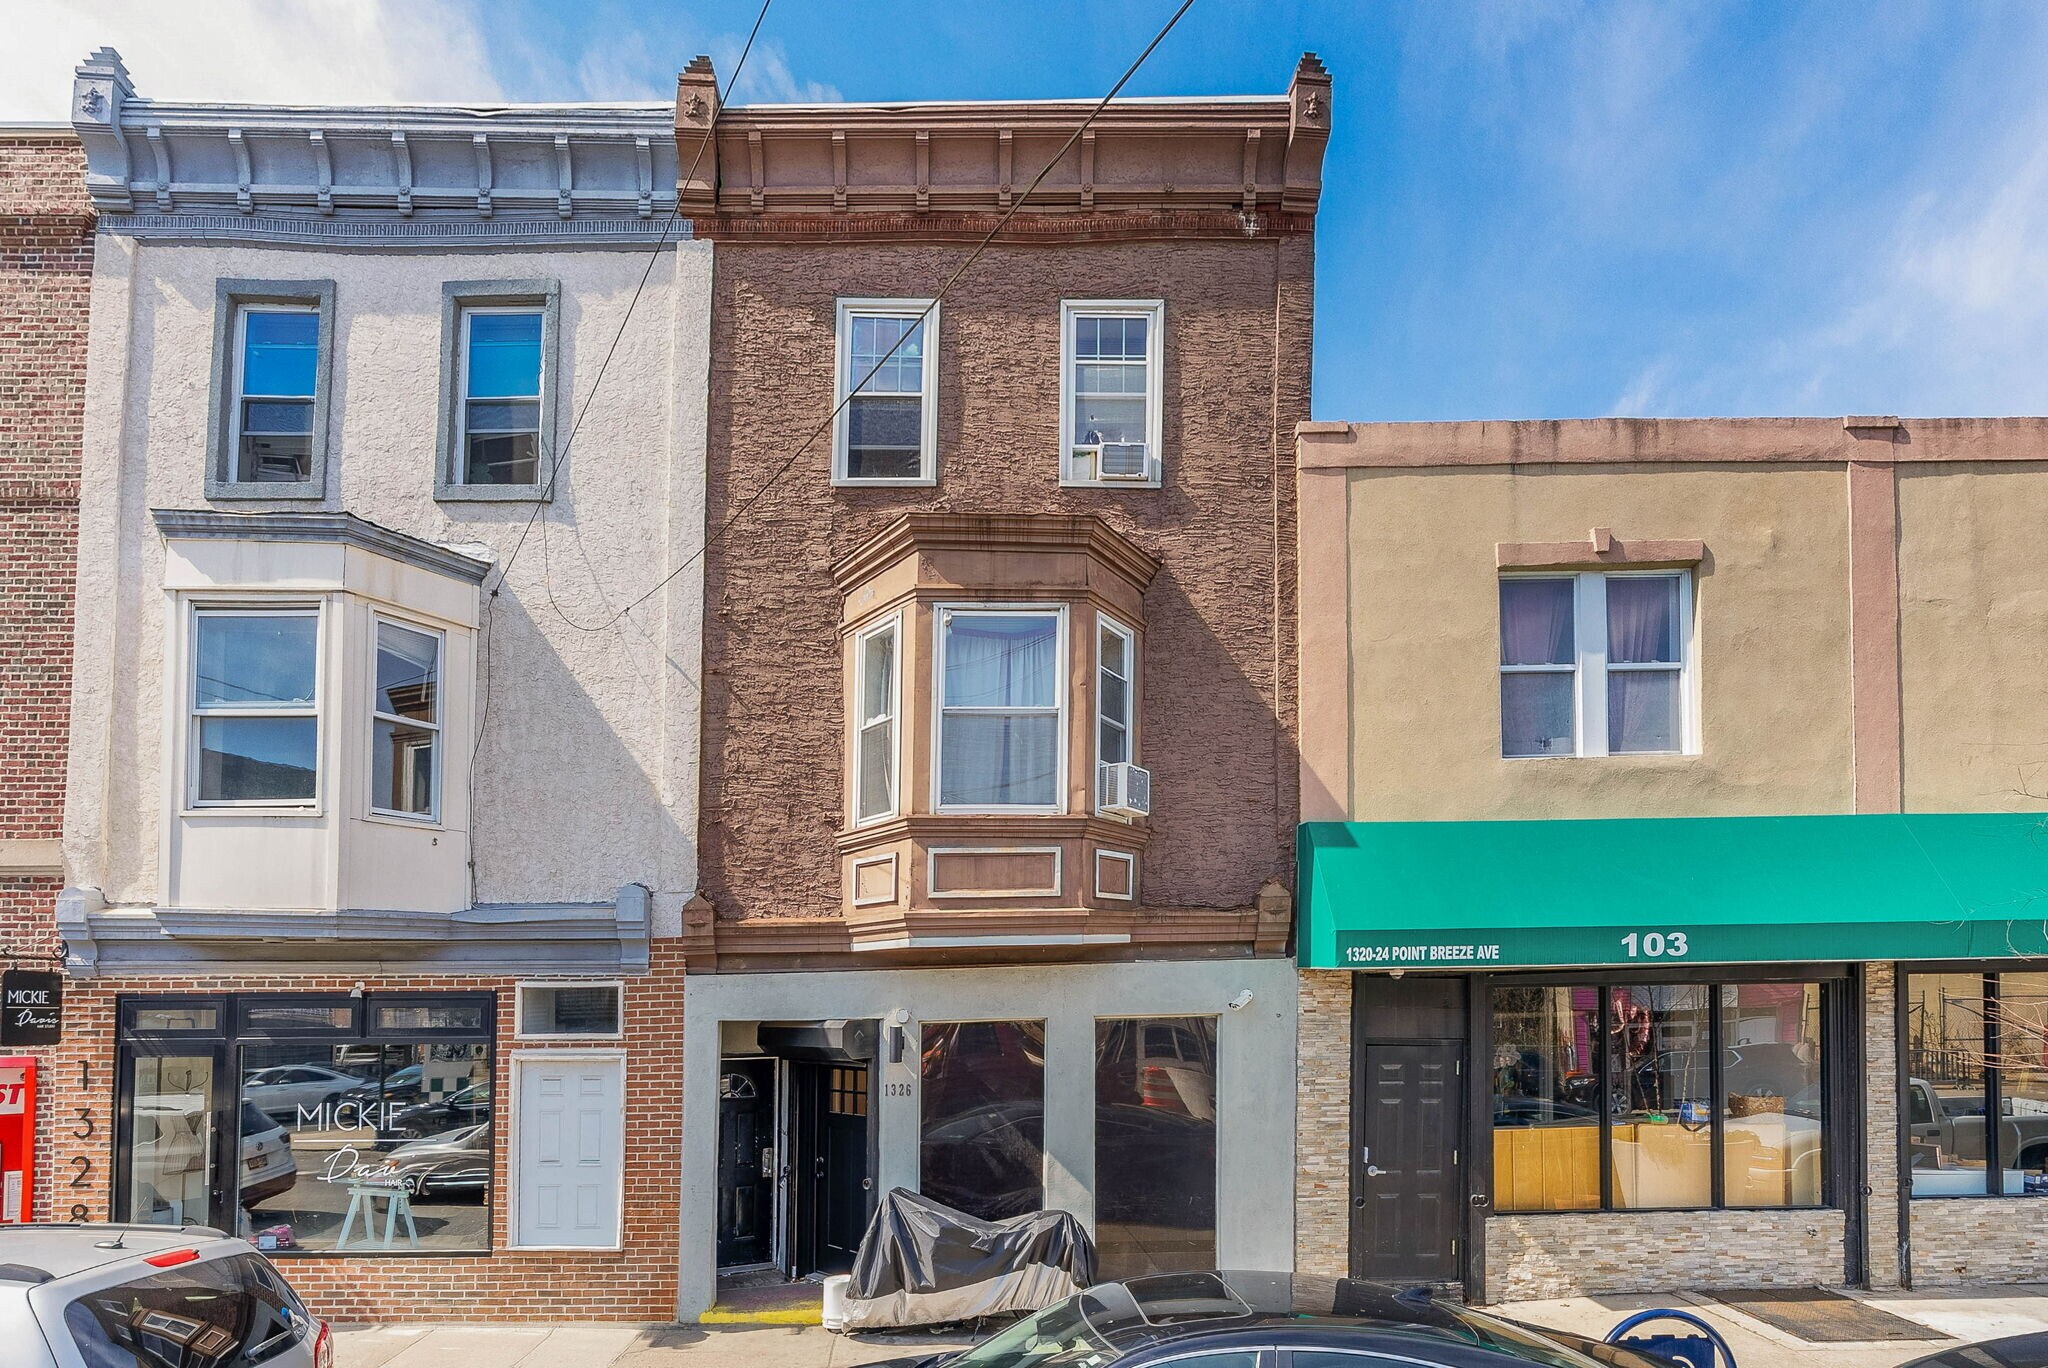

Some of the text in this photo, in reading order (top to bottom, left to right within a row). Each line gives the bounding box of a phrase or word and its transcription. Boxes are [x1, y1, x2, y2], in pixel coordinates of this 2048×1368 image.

[1346, 944, 1500, 962] 1320-24 POINT BREEZE AVE
[1621, 932, 1688, 957] 103
[7, 989, 50, 1004] MICKIE
[14, 1008, 60, 1027] Davis
[885, 1083, 912, 1097] 1326
[296, 1102, 407, 1132] MICKIE
[384, 1178, 403, 1187] HAIR
